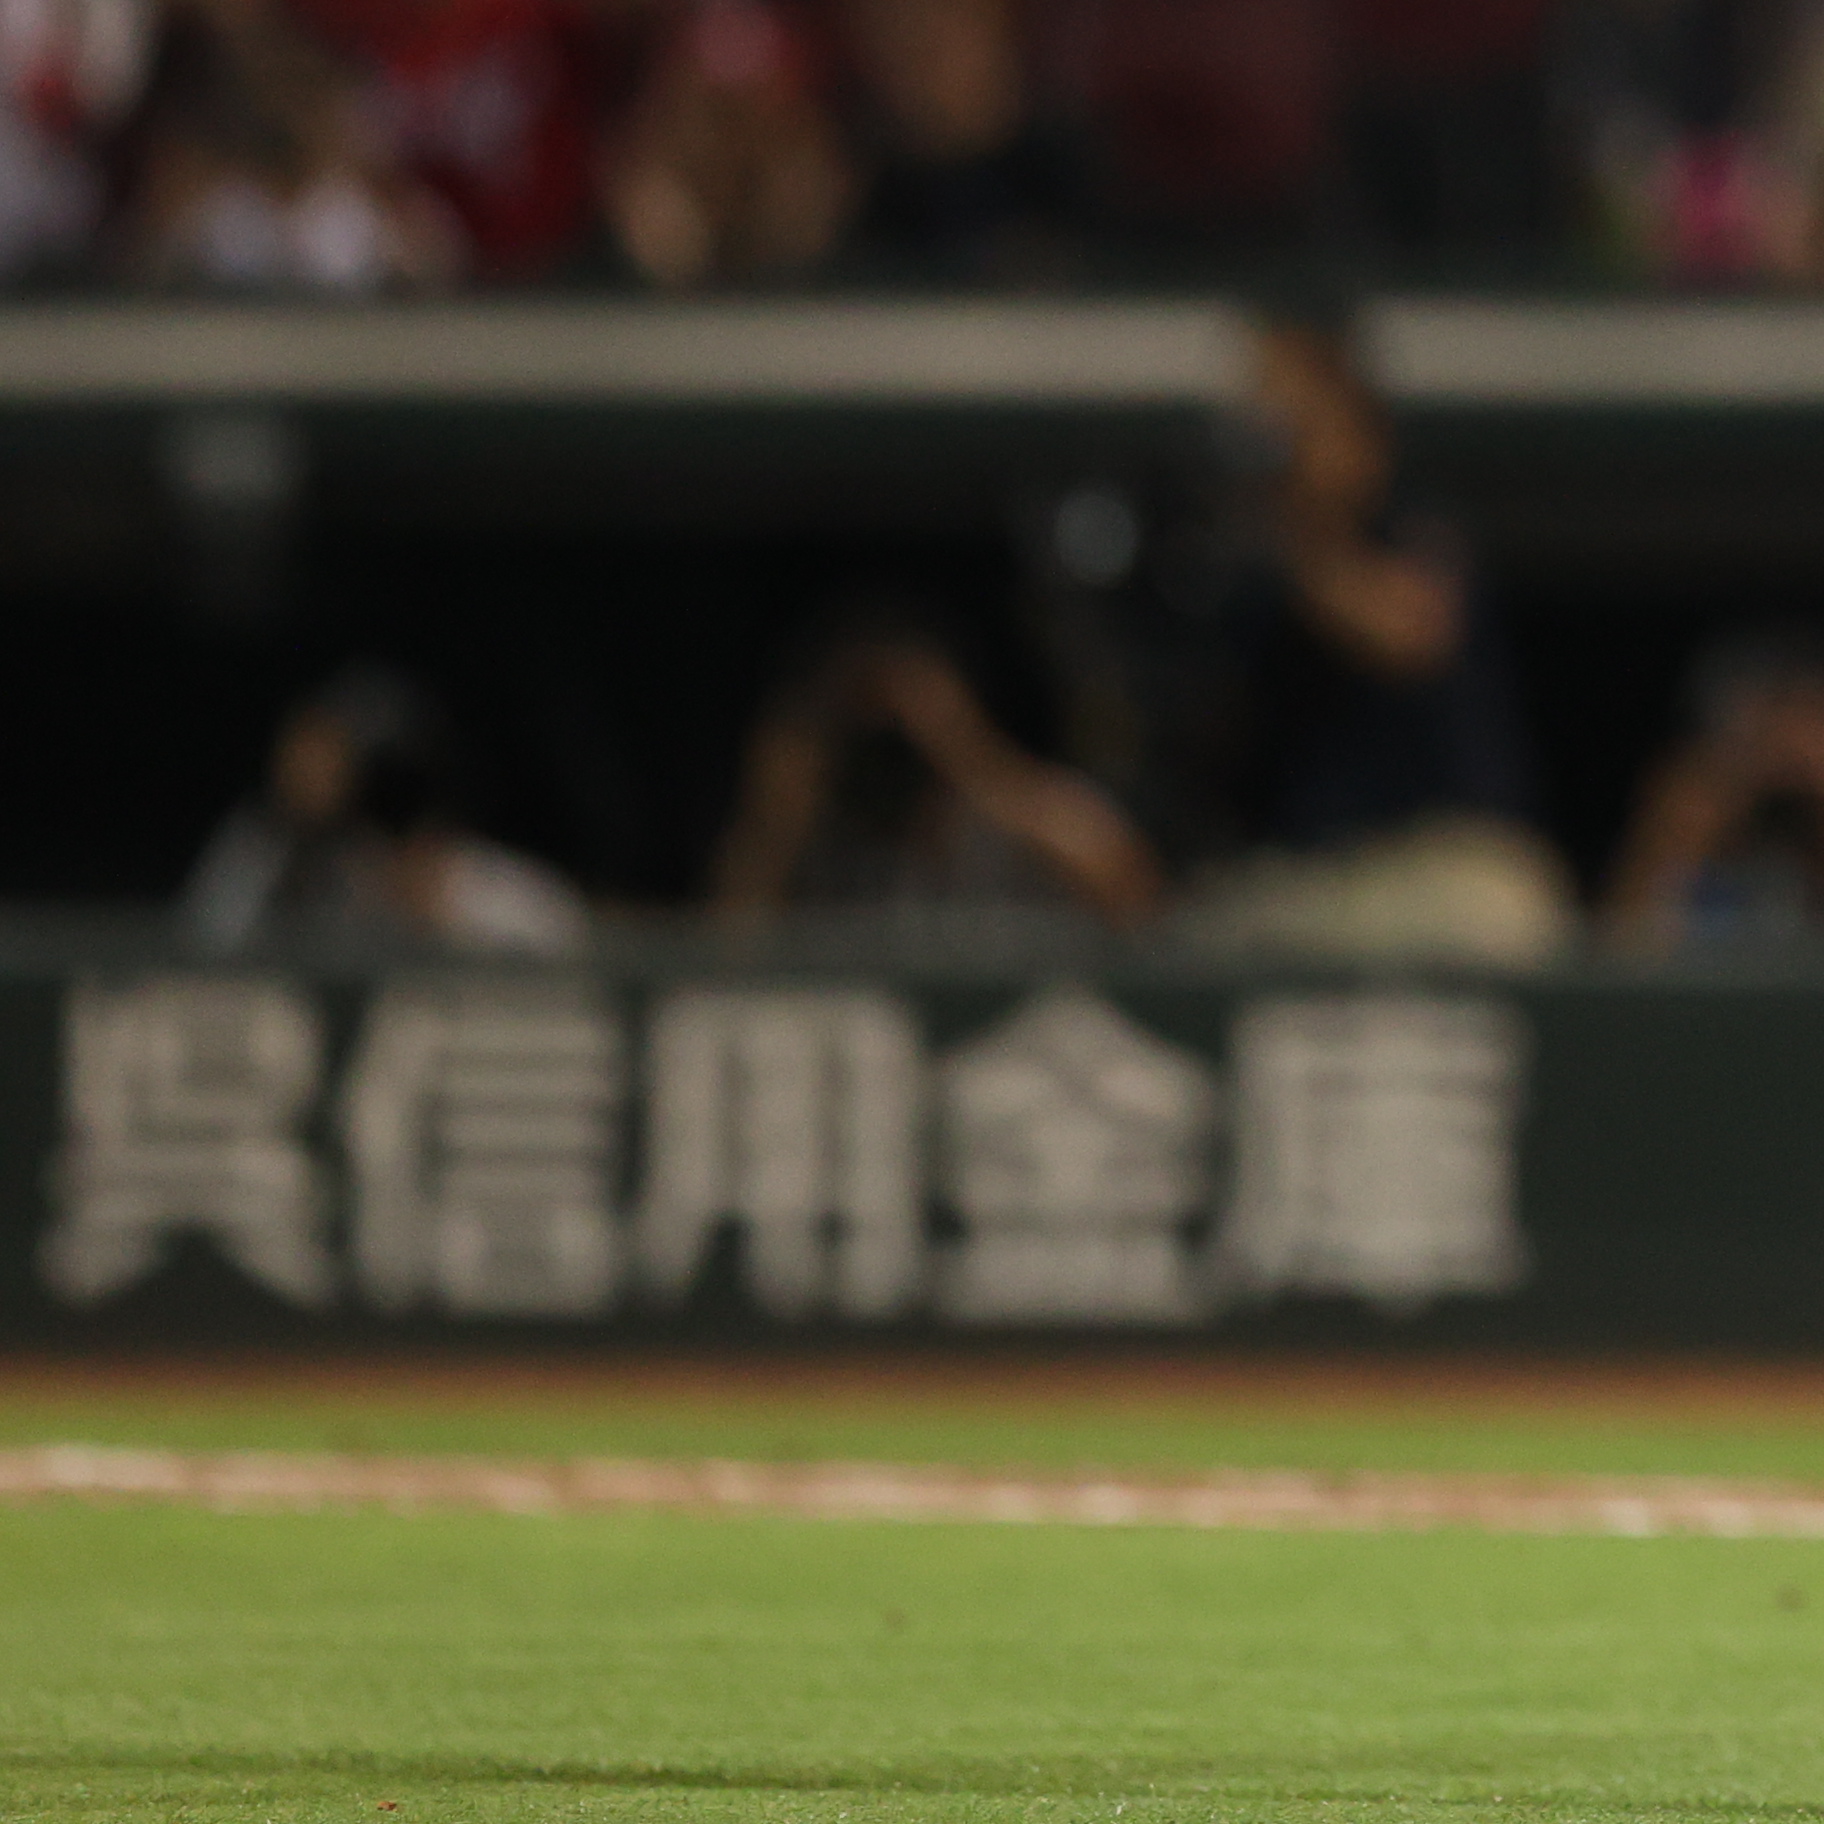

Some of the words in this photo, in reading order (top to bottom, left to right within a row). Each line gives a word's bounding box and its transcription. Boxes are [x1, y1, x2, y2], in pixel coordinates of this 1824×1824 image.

[46, 982, 1524, 1316] 呉信用金庫
